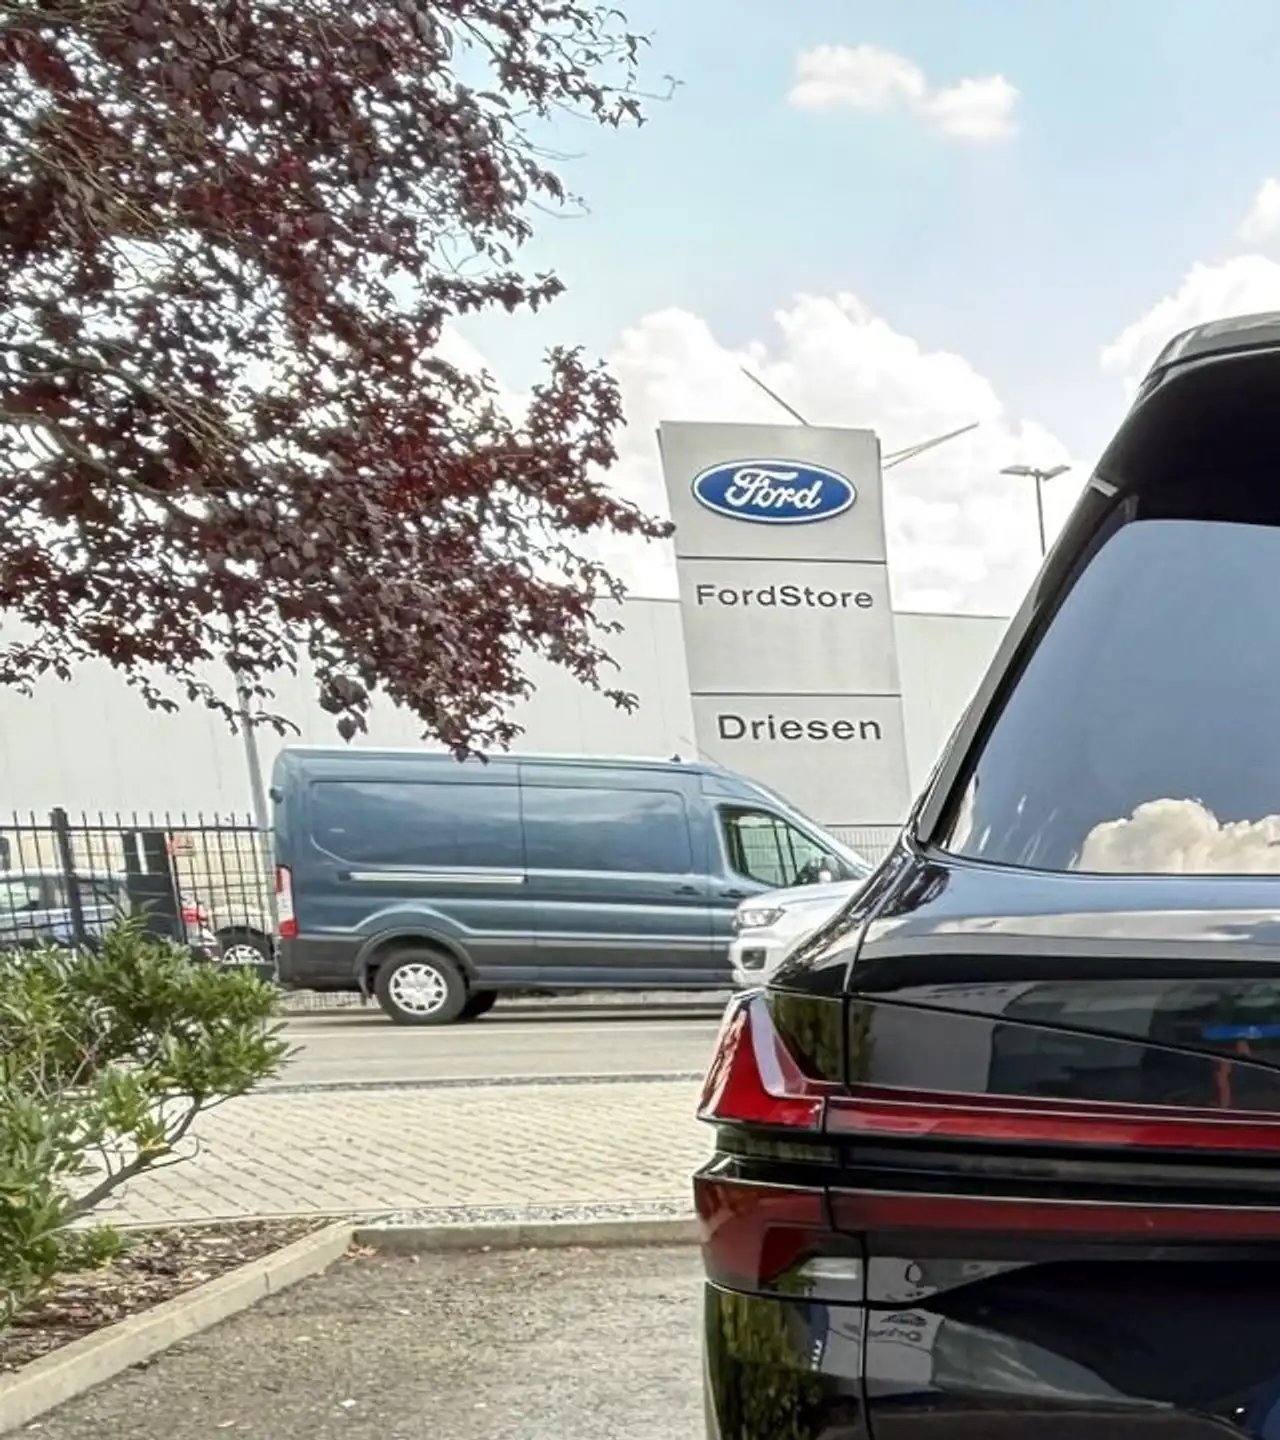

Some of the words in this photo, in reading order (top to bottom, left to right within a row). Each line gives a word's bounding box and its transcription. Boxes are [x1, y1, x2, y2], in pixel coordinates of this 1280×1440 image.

[725, 468, 823, 509] Ford
[696, 584, 874, 609] FordStore
[717, 714, 882, 740] Driesen
